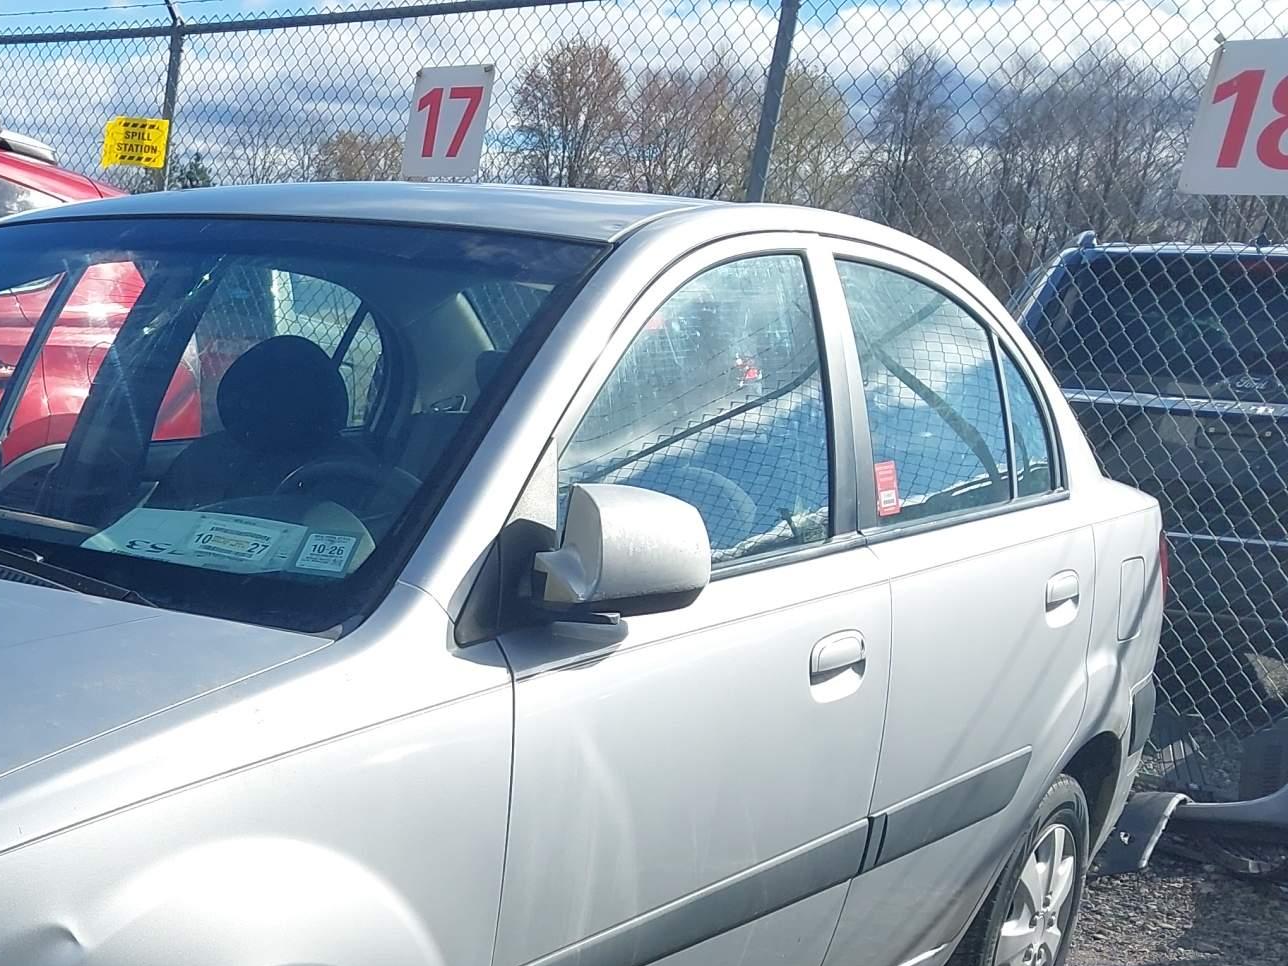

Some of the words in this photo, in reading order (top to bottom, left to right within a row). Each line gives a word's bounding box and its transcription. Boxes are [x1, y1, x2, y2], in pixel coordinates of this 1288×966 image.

[417, 86, 484, 157] 17
[124, 131, 152, 141] SPILL
[116, 143, 158, 153] STATION
[1236, 376, 1268, 389] Ford
[194, 533, 213, 544] 10
[248, 543, 269, 555] 27
[312, 543, 345, 555] 10-26
